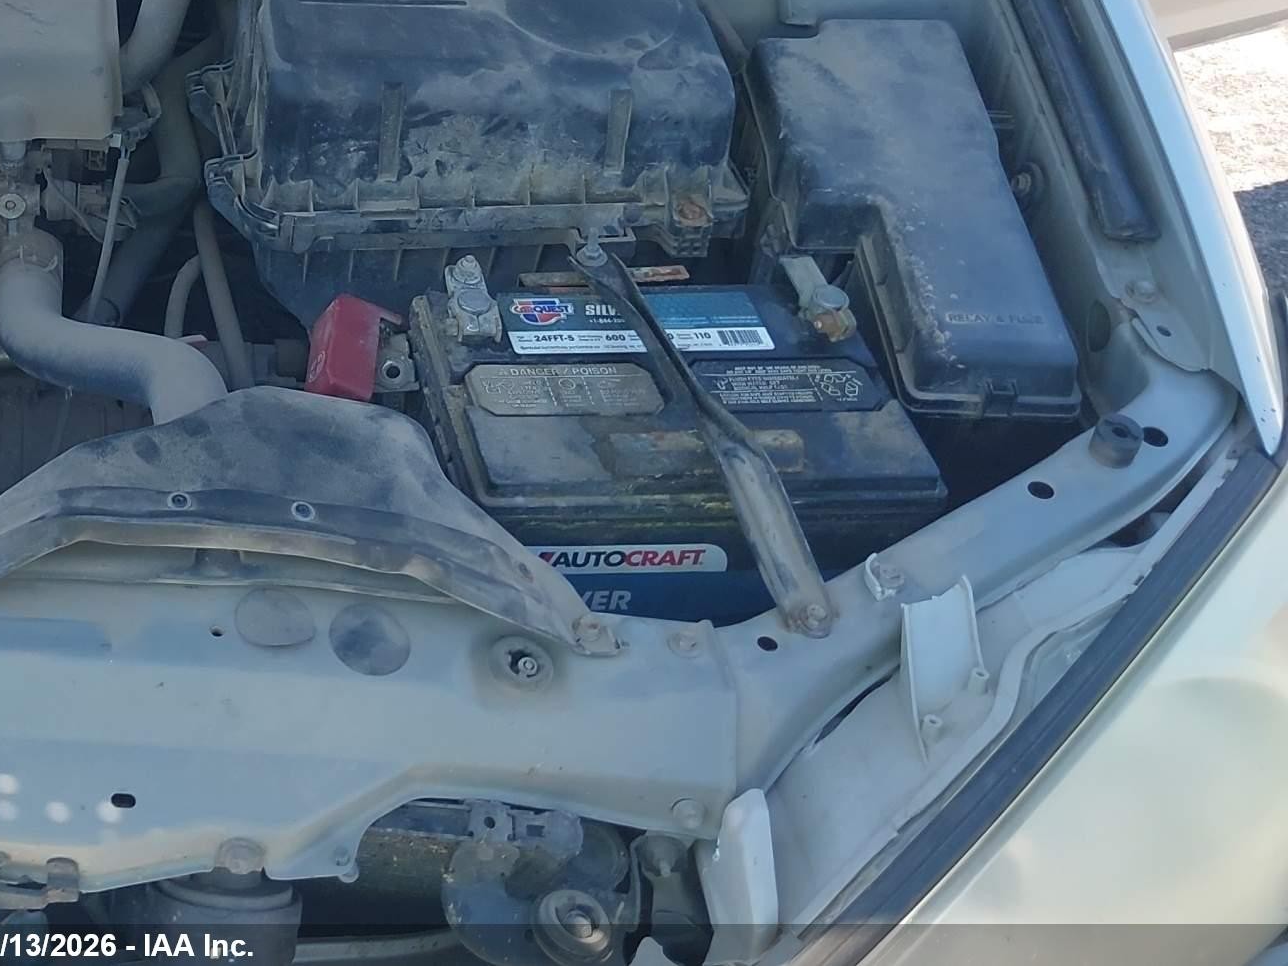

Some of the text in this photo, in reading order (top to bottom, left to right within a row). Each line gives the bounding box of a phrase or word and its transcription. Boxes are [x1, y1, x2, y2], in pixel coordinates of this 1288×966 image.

[585, 304, 620, 316] SILV
[605, 333, 626, 342] 600
[694, 332, 712, 340] 110
[509, 367, 559, 376] DANGER
[571, 366, 618, 375] POISON
[552, 549, 706, 568] AUTOCRAFT
